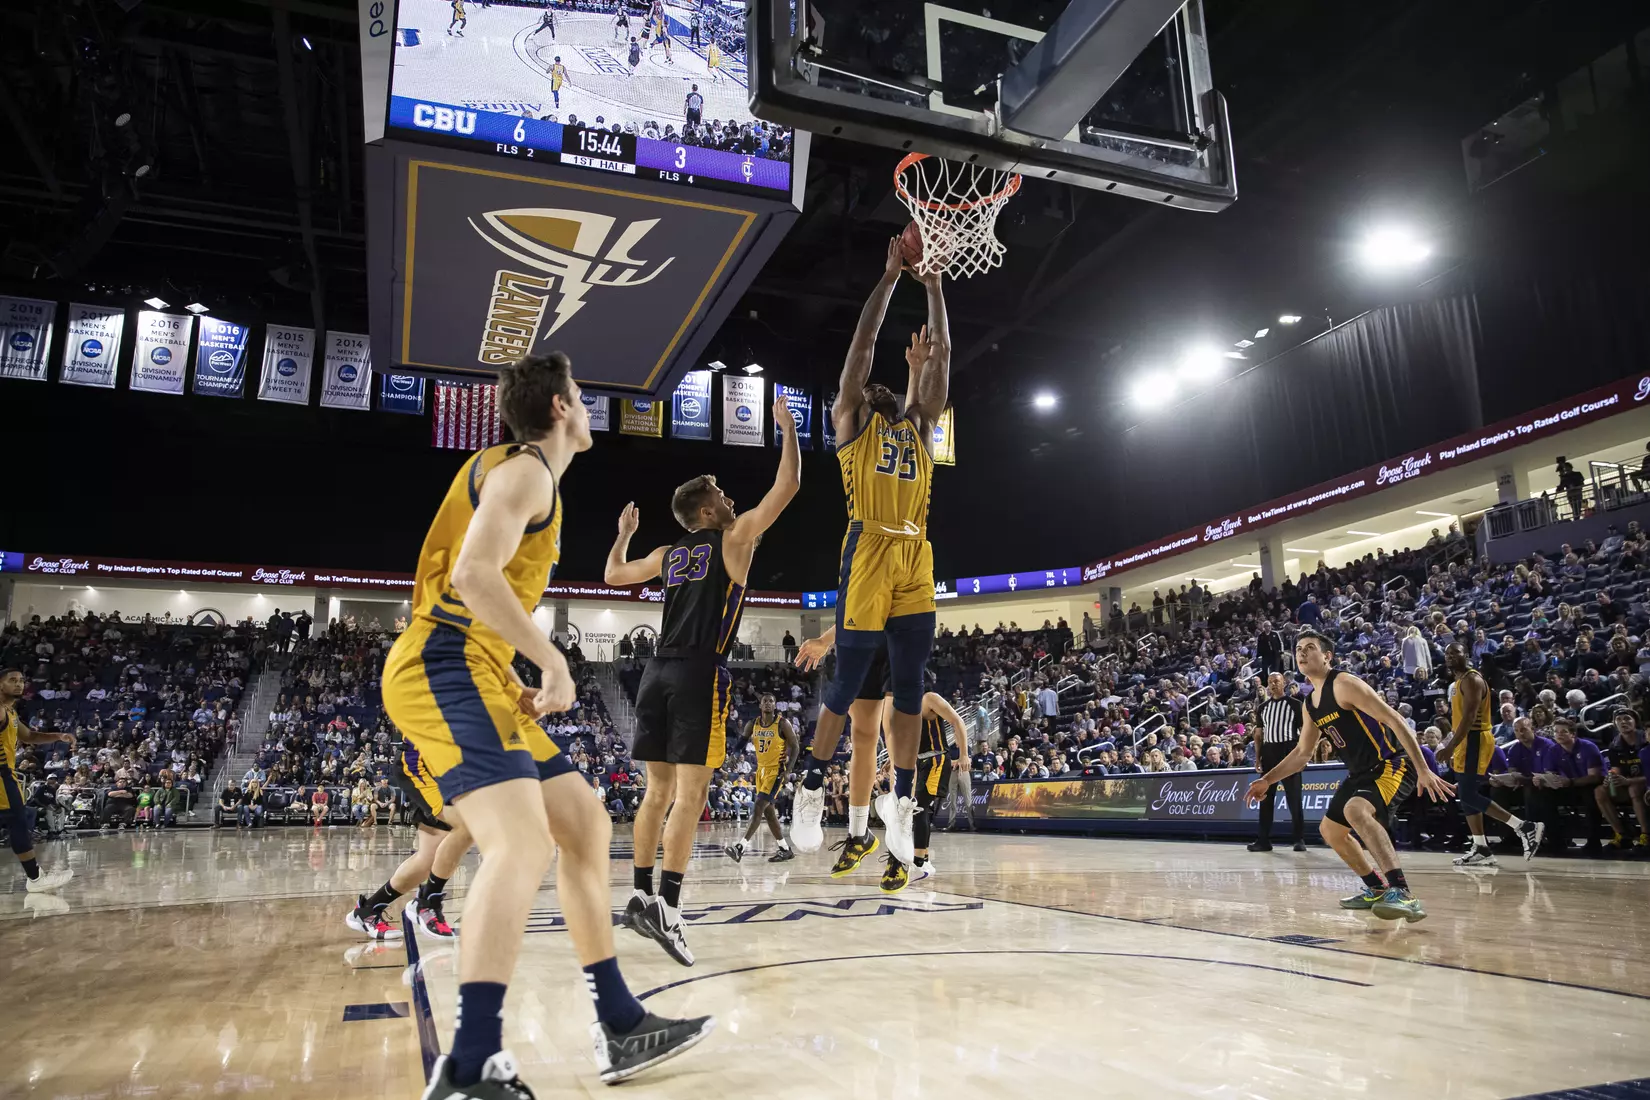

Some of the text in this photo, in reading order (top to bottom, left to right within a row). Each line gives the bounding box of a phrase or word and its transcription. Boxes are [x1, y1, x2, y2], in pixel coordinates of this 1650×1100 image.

[413, 104, 477, 135] CBU
[513, 120, 526, 142] 6
[578, 131, 622, 156] 15:44
[496, 144, 534, 157] FLS 2
[674, 147, 687, 168] 3
[573, 156, 628, 172] 1ST HALF
[659, 170, 694, 184] FLS 4
[9, 304, 43, 315] 2018
[81, 310, 110, 321] 2017
[478, 270, 556, 365] LANCERS
[150, 319, 179, 330] 2016
[150, 329, 175, 338] MEN'S
[211, 334, 236, 343] MEN'S
[276, 331, 304, 342] 2015
[200, 340, 245, 350] BASKETBALL
[277, 341, 300, 350] MEN'S
[336, 338, 364, 349] 2014
[266, 348, 310, 358] BASKETBALL
[71, 360, 99, 368] DIVISION
[63, 365, 113, 376] TOURNAMENT
[141, 367, 169, 375] DIVISION
[134, 372, 182, 383] TOURNAMENT
[265, 378, 299, 387] DIVISION
[267, 385, 292, 393] SWEET
[330, 384, 357, 393] DIVISION
[731, 381, 754, 391] 2016
[782, 385, 804, 396] 2017
[324, 390, 369, 399] TOURNAMENT
[380, 391, 422, 401] CHAMPIONS
[624, 413, 653, 421] DIVISION
[623, 424, 650, 433] RUNNER
[671, 419, 709, 428] CHAMPIONS
[729, 423, 753, 431] DIVISION
[1440, 394, 1619, 460] Play Inland Empire's Top Rated Golf Course!
[725, 428, 762, 437] TOURNAMENT
[875, 440, 918, 482] 35
[1376, 453, 1432, 485] Goose Creek
[1388, 468, 1421, 484] GOLF CLUB
[1248, 515, 1262, 524] Book
[1261, 505, 1287, 519] TeeTimes
[28, 557, 90, 570] Goose Creek
[667, 543, 713, 588] 23
[97, 564, 113, 572] Play
[136, 565, 166, 575] Empire's
[167, 567, 180, 575] Top
[181, 568, 201, 576] Rated
[216, 570, 243, 578] Course!
[251, 567, 306, 581] Goose Creek
[314, 574, 331, 582] Book
[331, 575, 362, 584] TeeTimes
[369, 578, 417, 587] www.goosecre
[973, 579, 981, 593] 3
[568, 587, 580, 595] Top
[580, 587, 598, 595] Rated
[609, 588, 632, 597] Course!
[638, 587, 662, 600] Goose
[745, 596, 800, 605] w.goosecreekgc.com
[1329, 780, 1341, 790] of
[1151, 780, 1195, 811] Goose
[1195, 779, 1240, 804] Creek
[1168, 804, 1215, 815] GOLF CLUB
